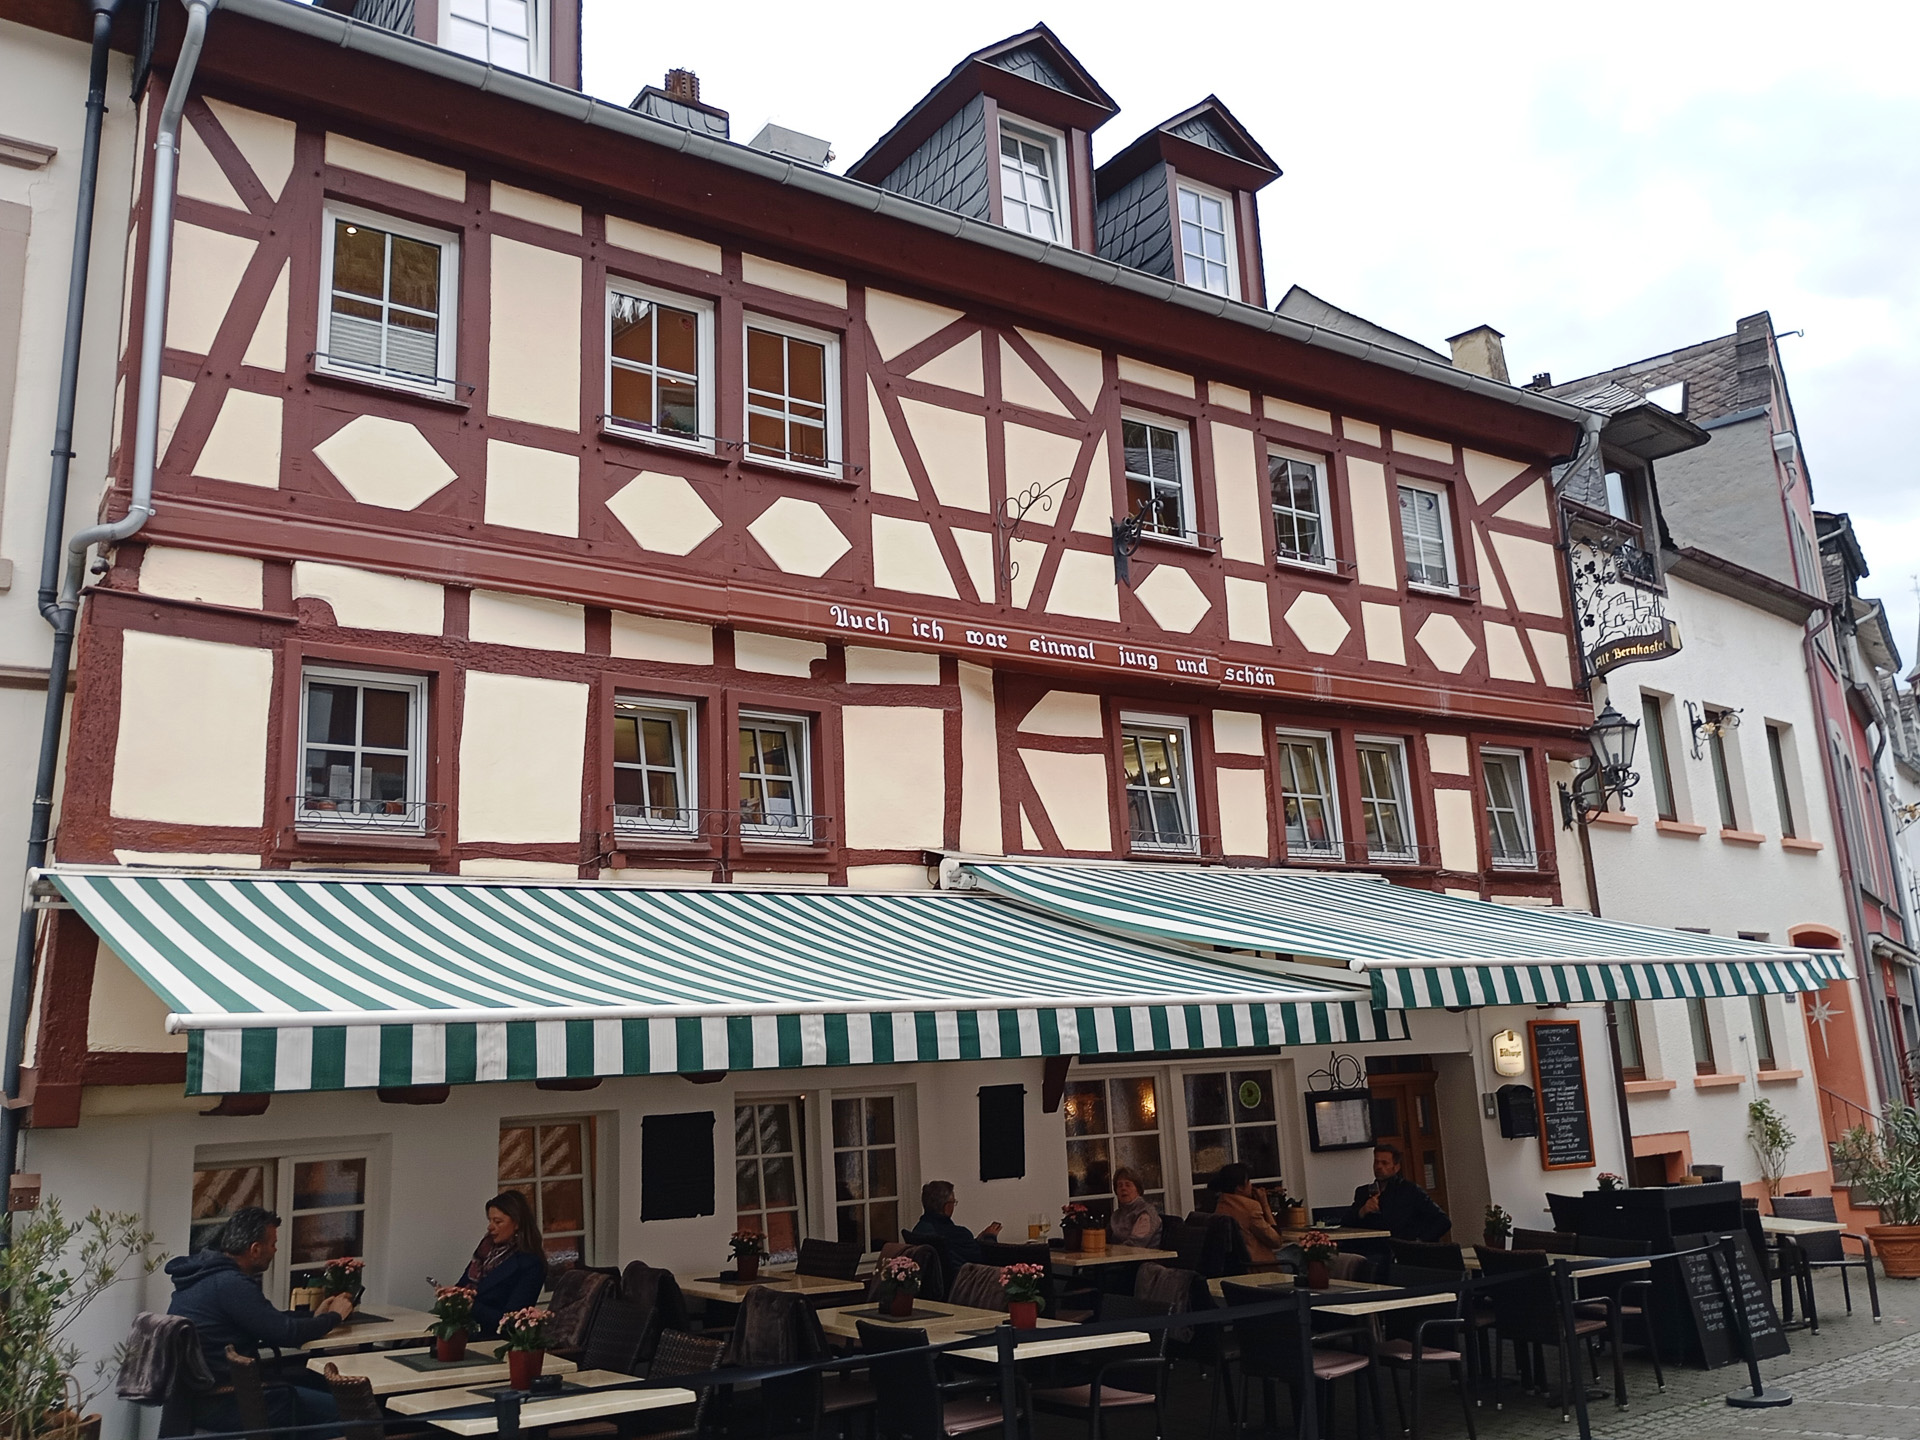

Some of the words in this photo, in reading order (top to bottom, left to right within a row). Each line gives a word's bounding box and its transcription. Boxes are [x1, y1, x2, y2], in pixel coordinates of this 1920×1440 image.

[829, 605, 889, 634] Auch
[911, 616, 944, 642] ich
[965, 630, 1007, 649] war
[1028, 634, 1096, 660] einmal
[1118, 645, 1158, 670] jung
[1174, 657, 1209, 675] und
[1224, 665, 1275, 686] schön
[1595, 652, 1609, 669] Alt
[1612, 640, 1666, 659] Bernkastel
